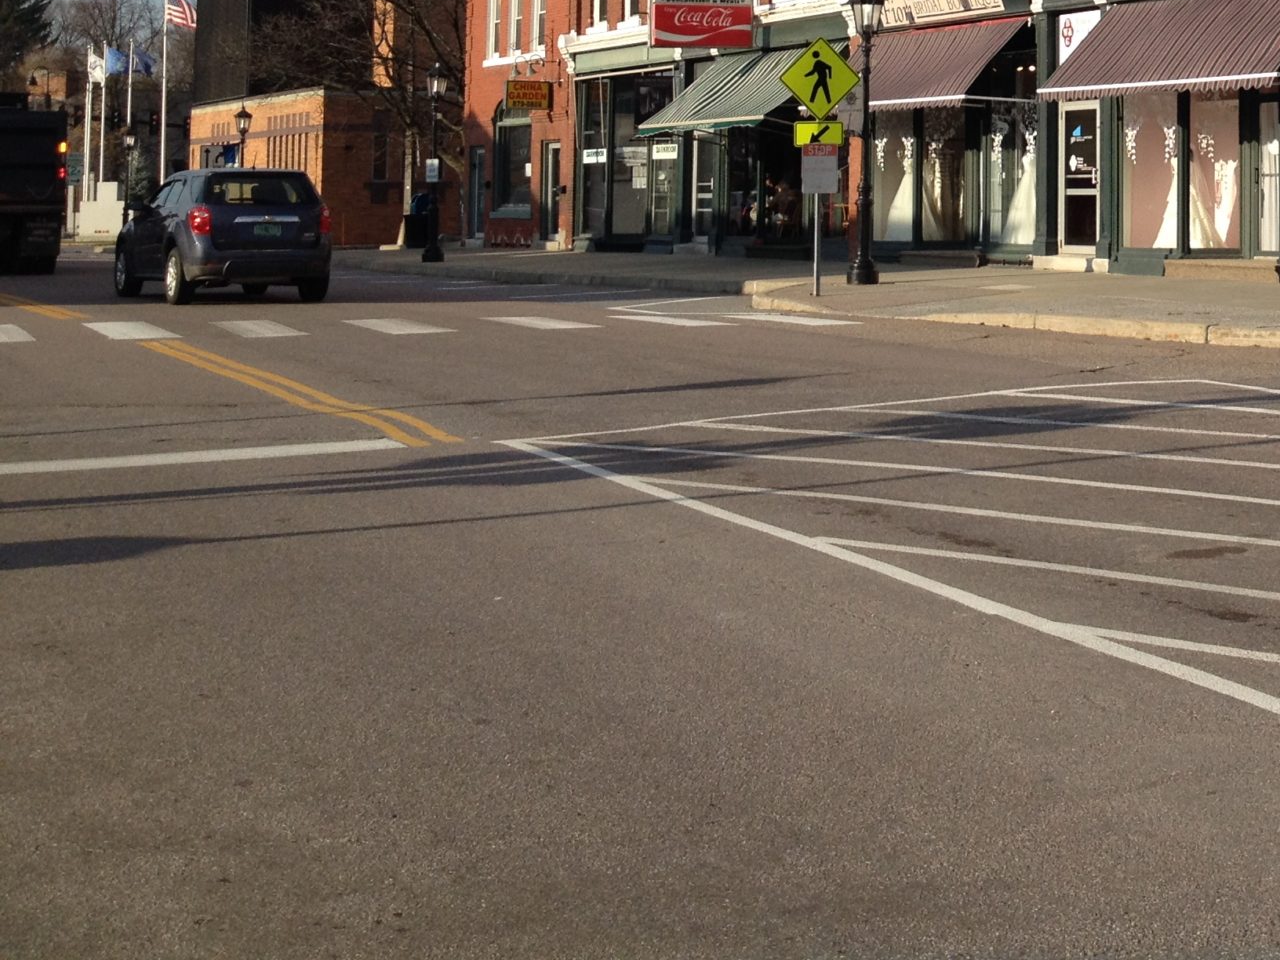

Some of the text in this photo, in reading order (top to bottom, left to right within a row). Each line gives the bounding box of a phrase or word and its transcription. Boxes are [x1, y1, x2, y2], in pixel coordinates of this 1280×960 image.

[512, 83, 543, 91] CHINA
[508, 91, 547, 100] GARDEN
[808, 145, 832, 156] STOP
